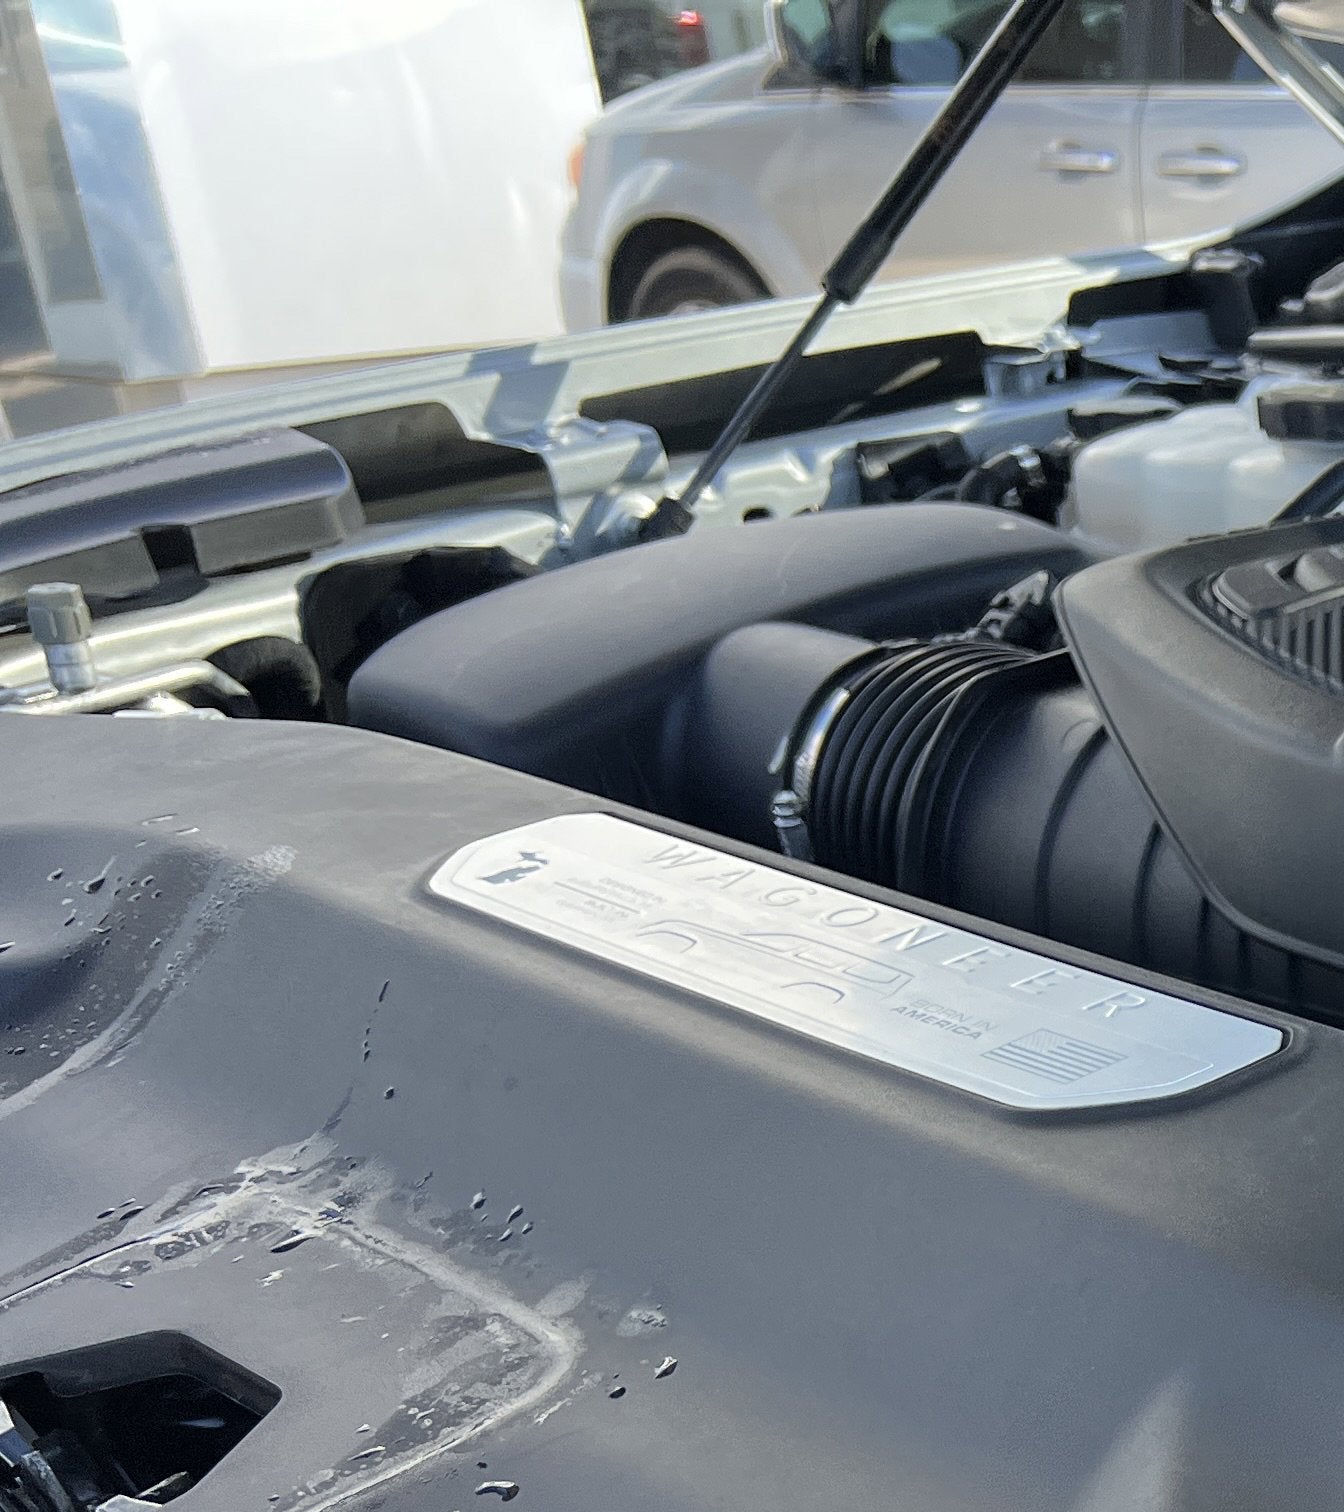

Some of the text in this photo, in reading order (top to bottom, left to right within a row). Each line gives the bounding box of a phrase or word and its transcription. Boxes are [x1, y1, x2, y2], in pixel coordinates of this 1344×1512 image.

[643, 843, 1146, 1018] WAGONEER
[890, 1005, 985, 1040] AMERICA
[909, 999, 1000, 1032] BORN IN
